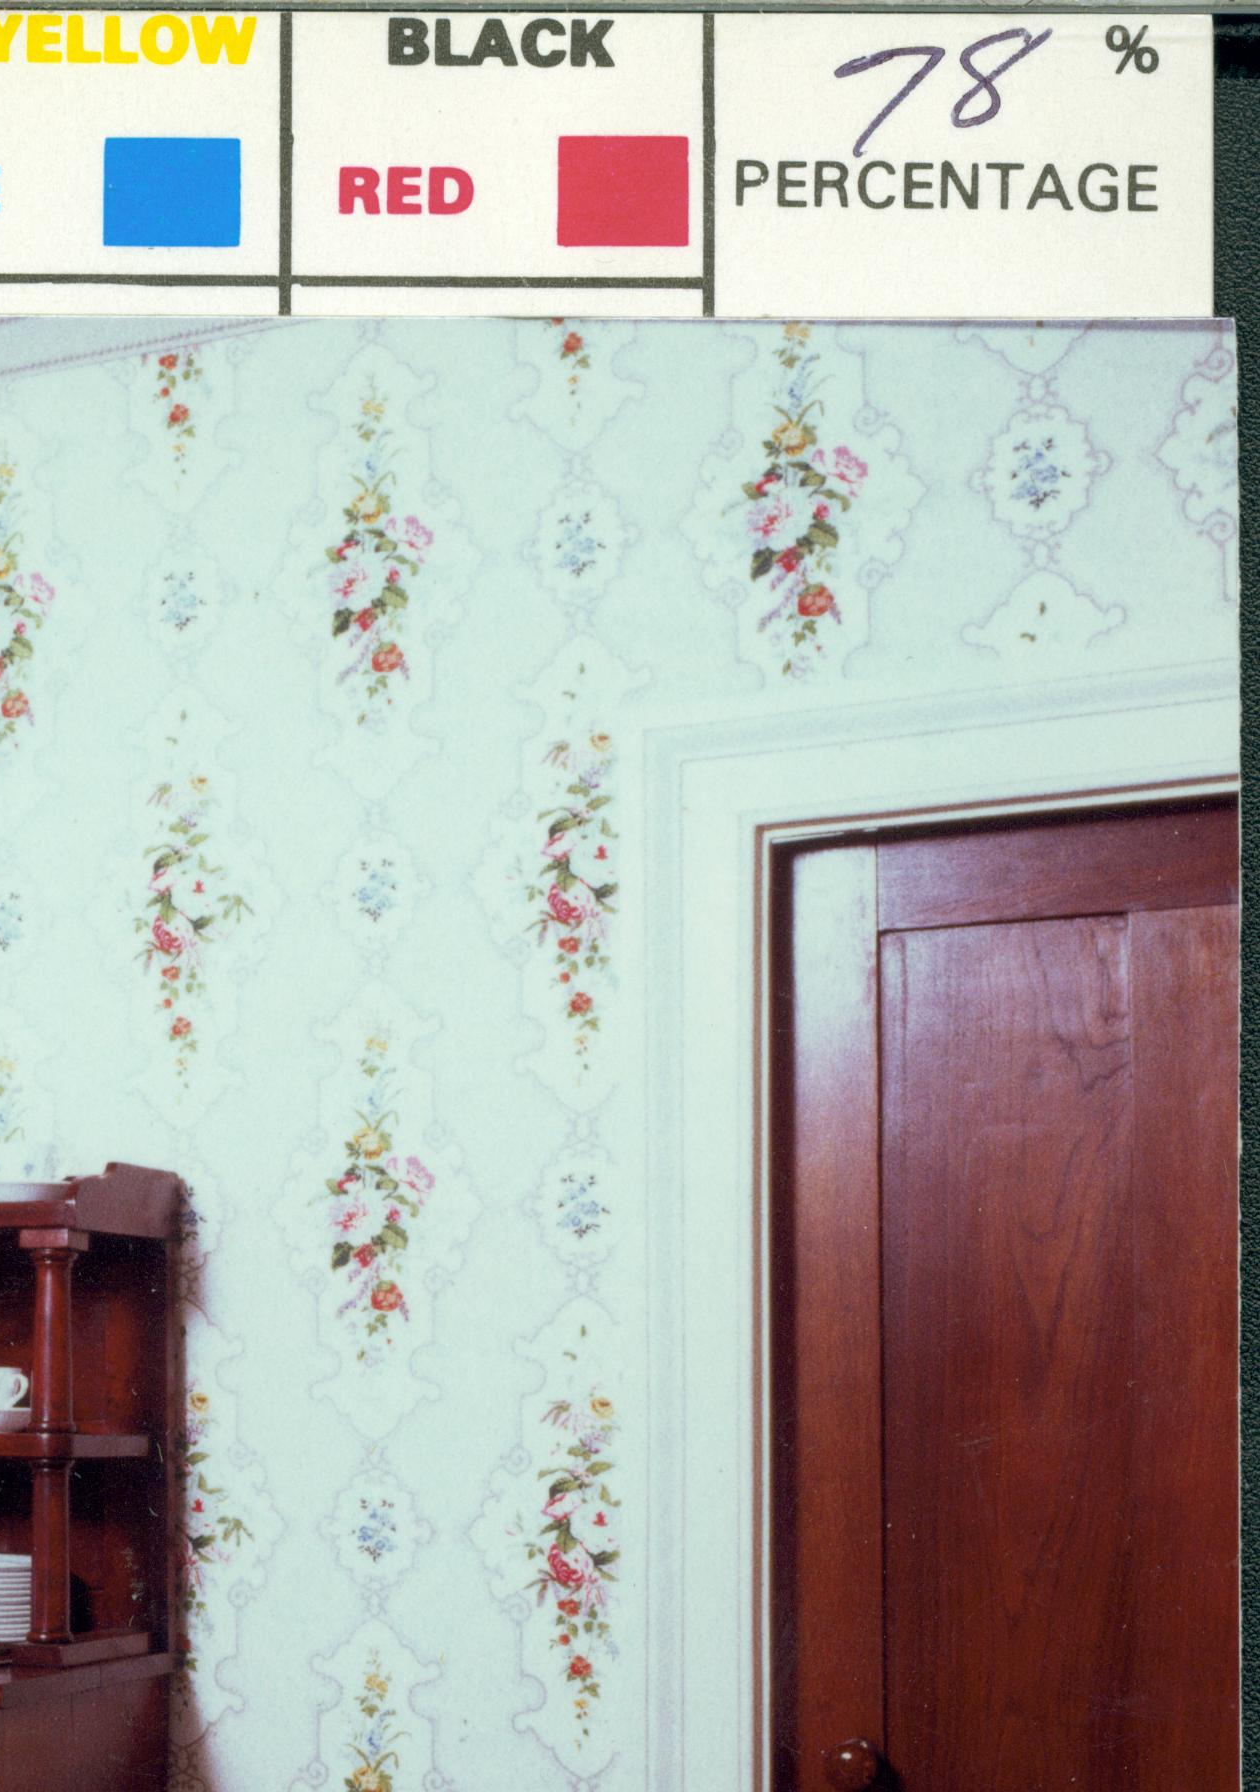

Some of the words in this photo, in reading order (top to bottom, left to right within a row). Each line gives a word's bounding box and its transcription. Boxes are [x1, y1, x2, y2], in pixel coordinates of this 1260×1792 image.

[388, 17, 615, 69] BLACK
[1105, 24, 1160, 75] %
[834, 26, 1053, 157] 78
[338, 166, 474, 215] RED
[735, 159, 1159, 212] PERCENTAGE
